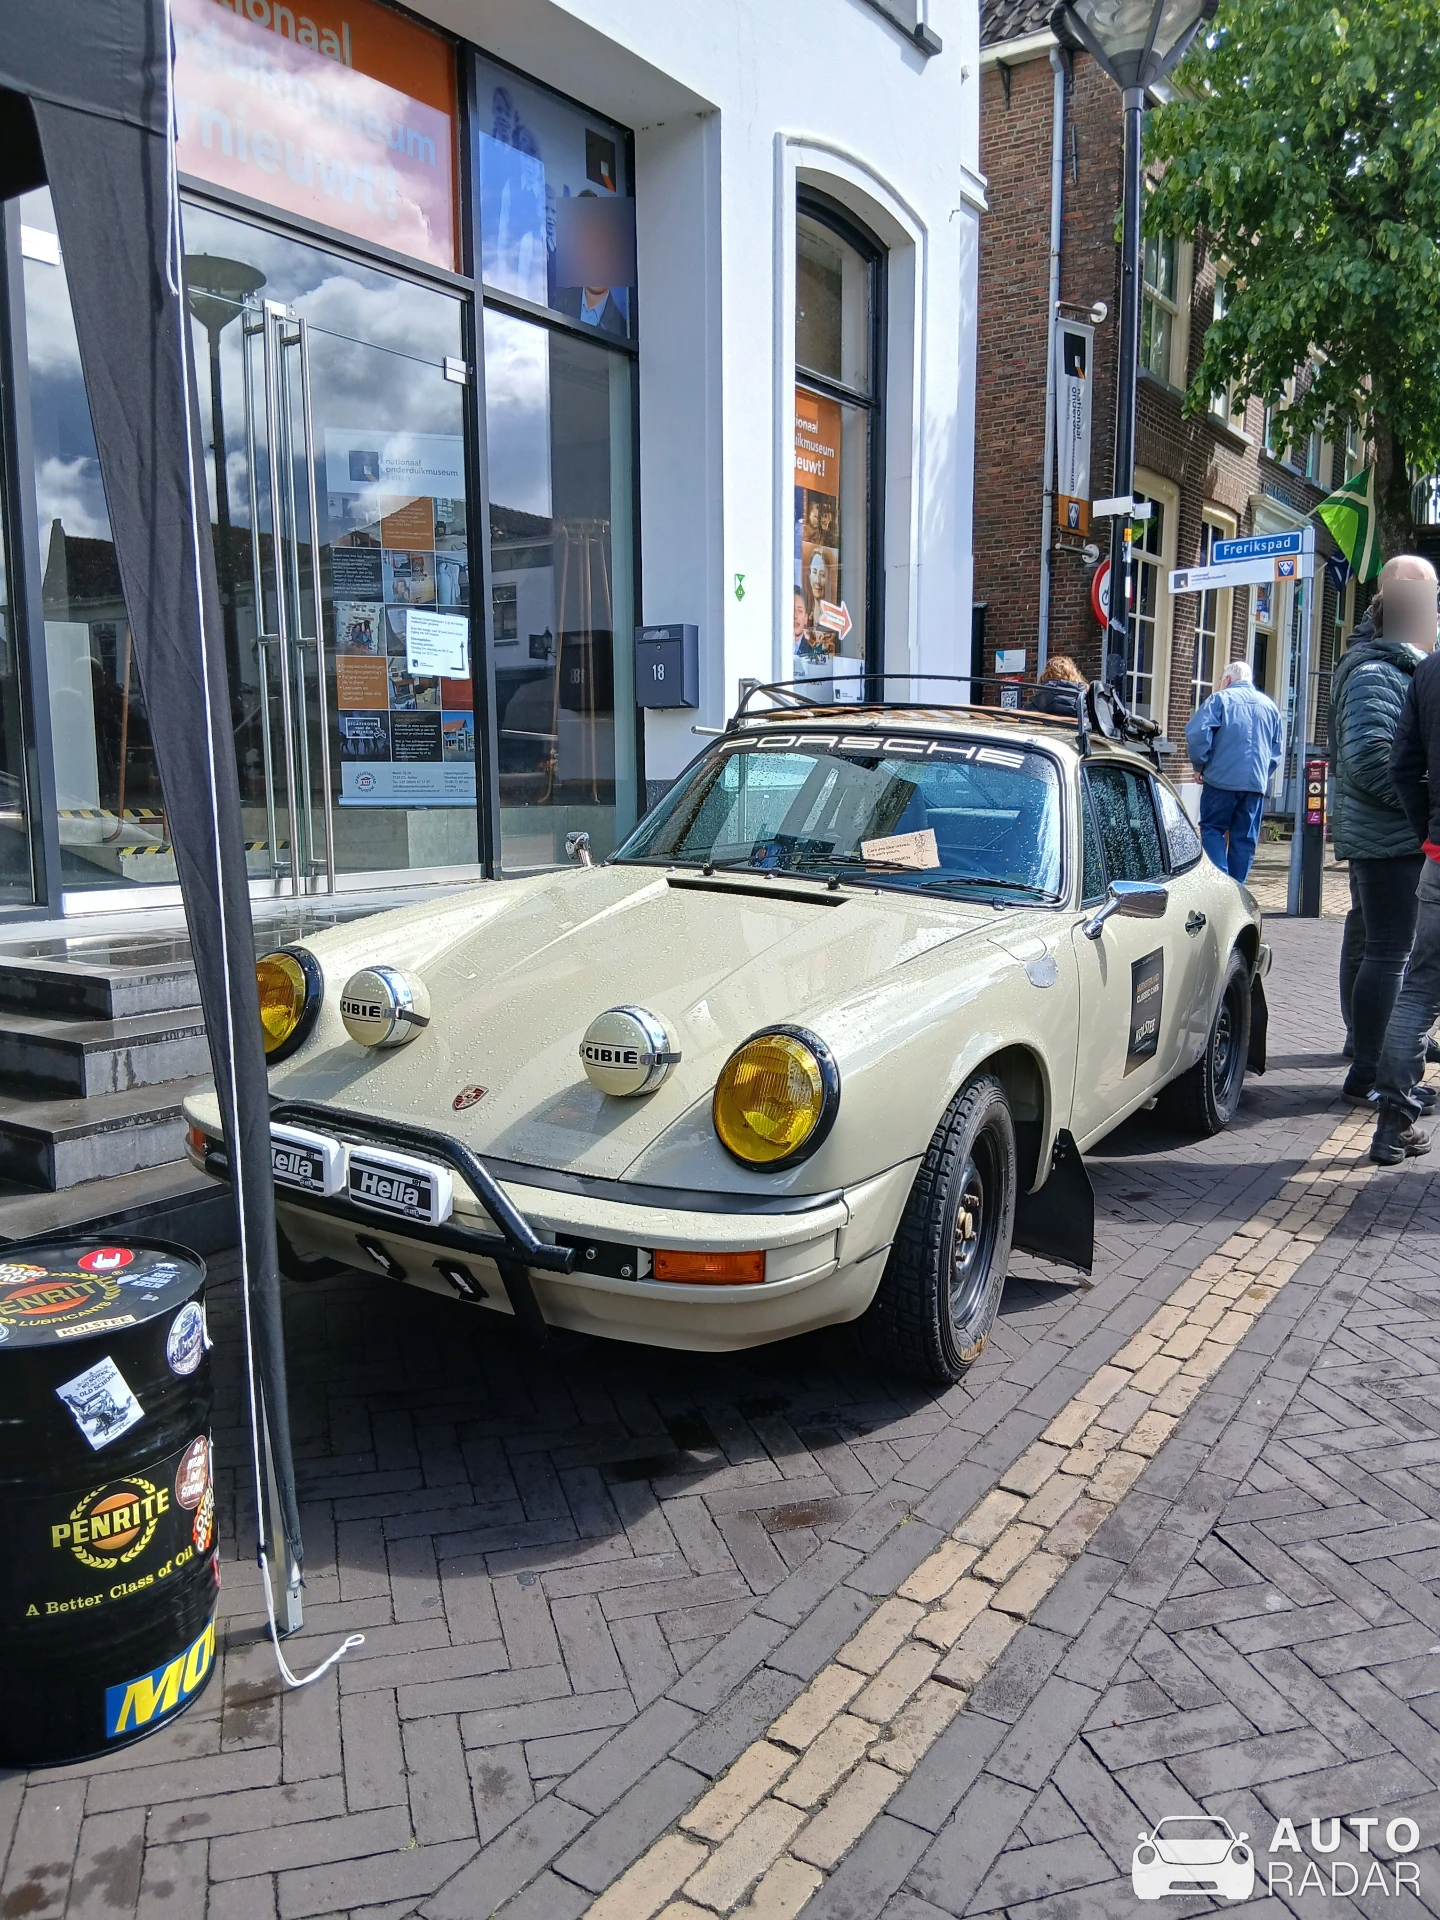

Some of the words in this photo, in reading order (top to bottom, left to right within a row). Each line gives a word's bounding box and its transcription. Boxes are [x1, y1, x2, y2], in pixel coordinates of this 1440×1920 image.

[232, 0, 352, 68] onaal
[795, 414, 818, 434] ionaal
[385, 459, 421, 467] nationaal
[385, 467, 459, 477] onderduikmuseum
[1223, 537, 1291, 556] Frerikspad
[652, 664, 665, 680] 18
[717, 735, 1025, 769] PORSCHE
[361, 1171, 419, 1206] Hella
[19, 1301, 112, 1326] LUBRICANTS
[61, 1316, 132, 1336] KOLSTEE
[79, 1388, 94, 1398] OLD
[93, 1371, 118, 1391] SCHOOL
[51, 1487, 170, 1548] PENRITE
[25, 1604, 40, 1616] A
[45, 1593, 103, 1615] Better
[109, 1573, 154, 1599] Class
[158, 1560, 172, 1578] of
[175, 1545, 194, 1566] Oil
